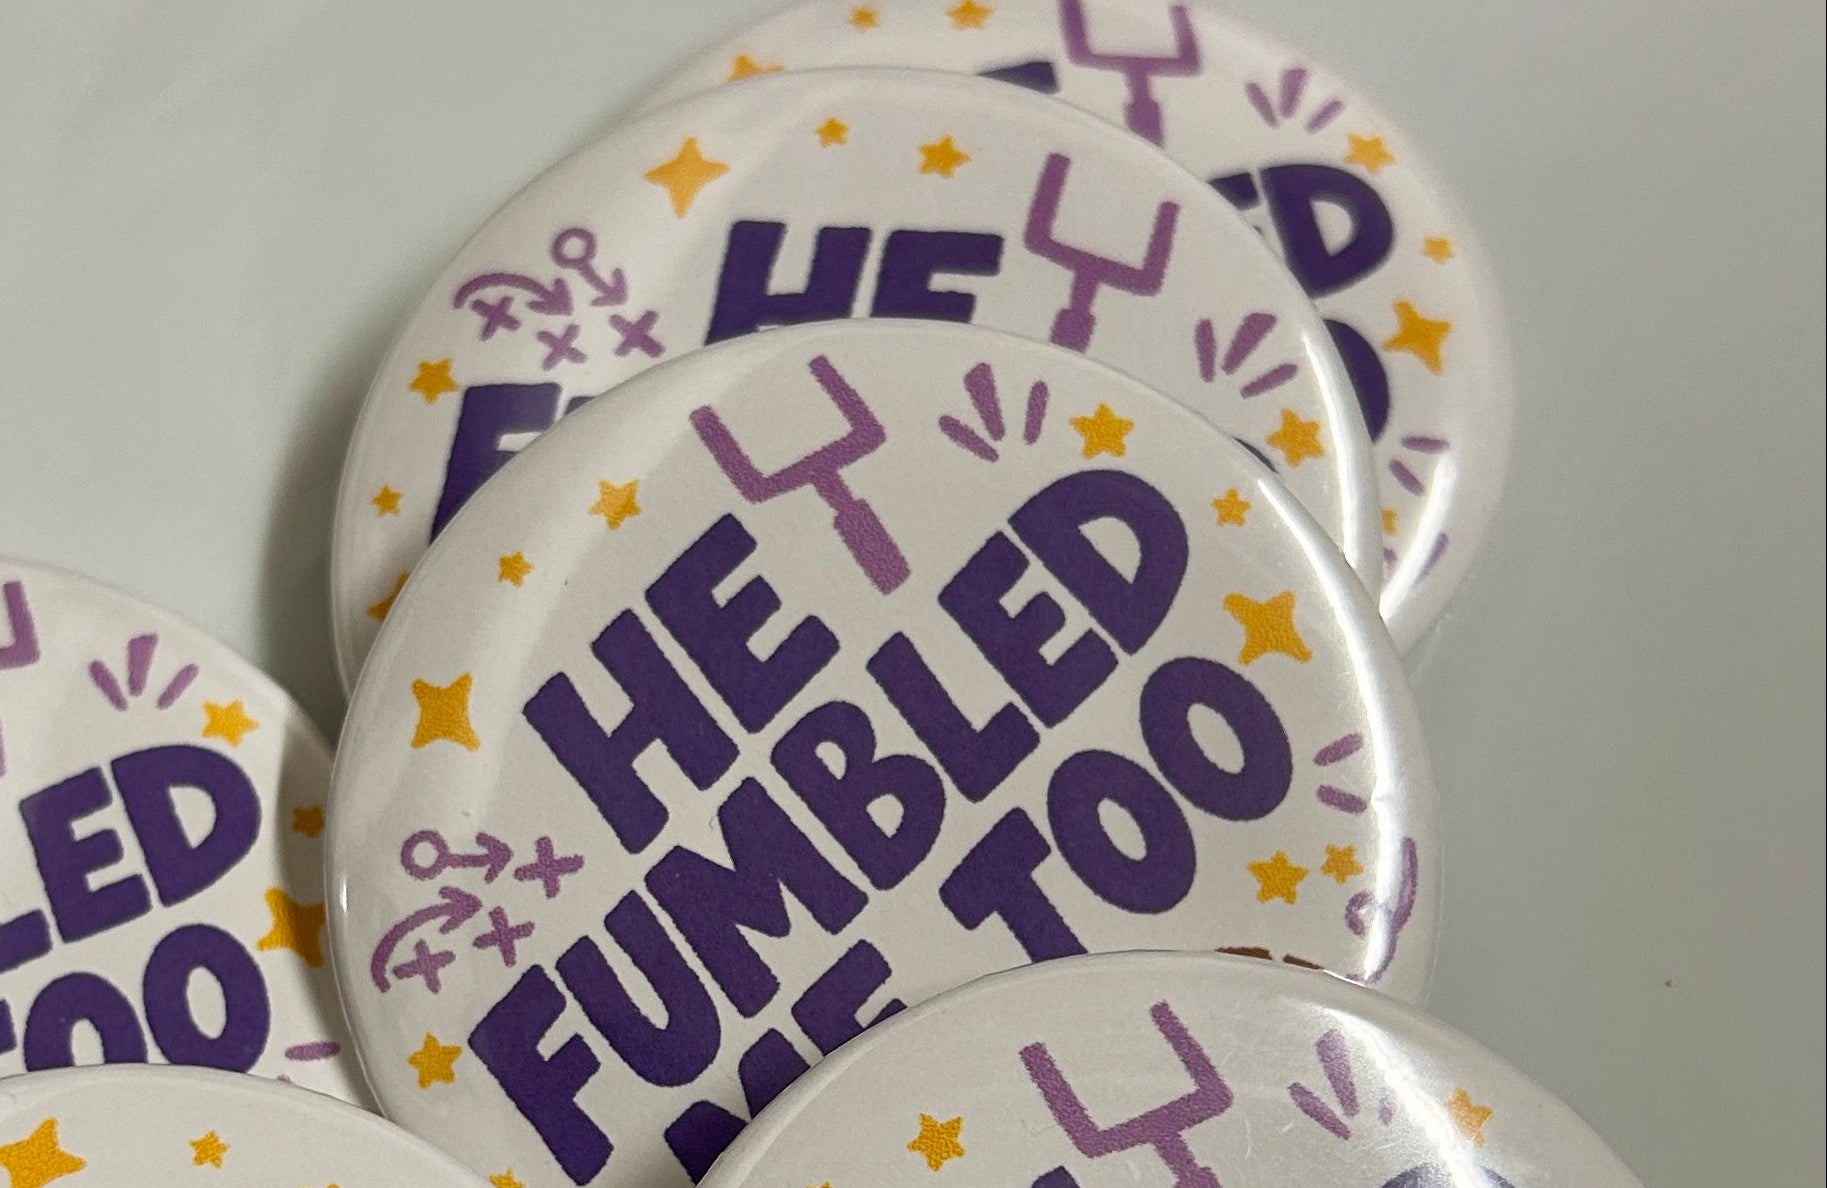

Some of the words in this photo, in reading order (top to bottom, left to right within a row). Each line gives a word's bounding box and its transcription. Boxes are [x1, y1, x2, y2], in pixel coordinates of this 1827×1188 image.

[466, 468, 1190, 1188] FUMBLED
[522, 511, 841, 855] HE
[938, 656, 1294, 963] TOO
